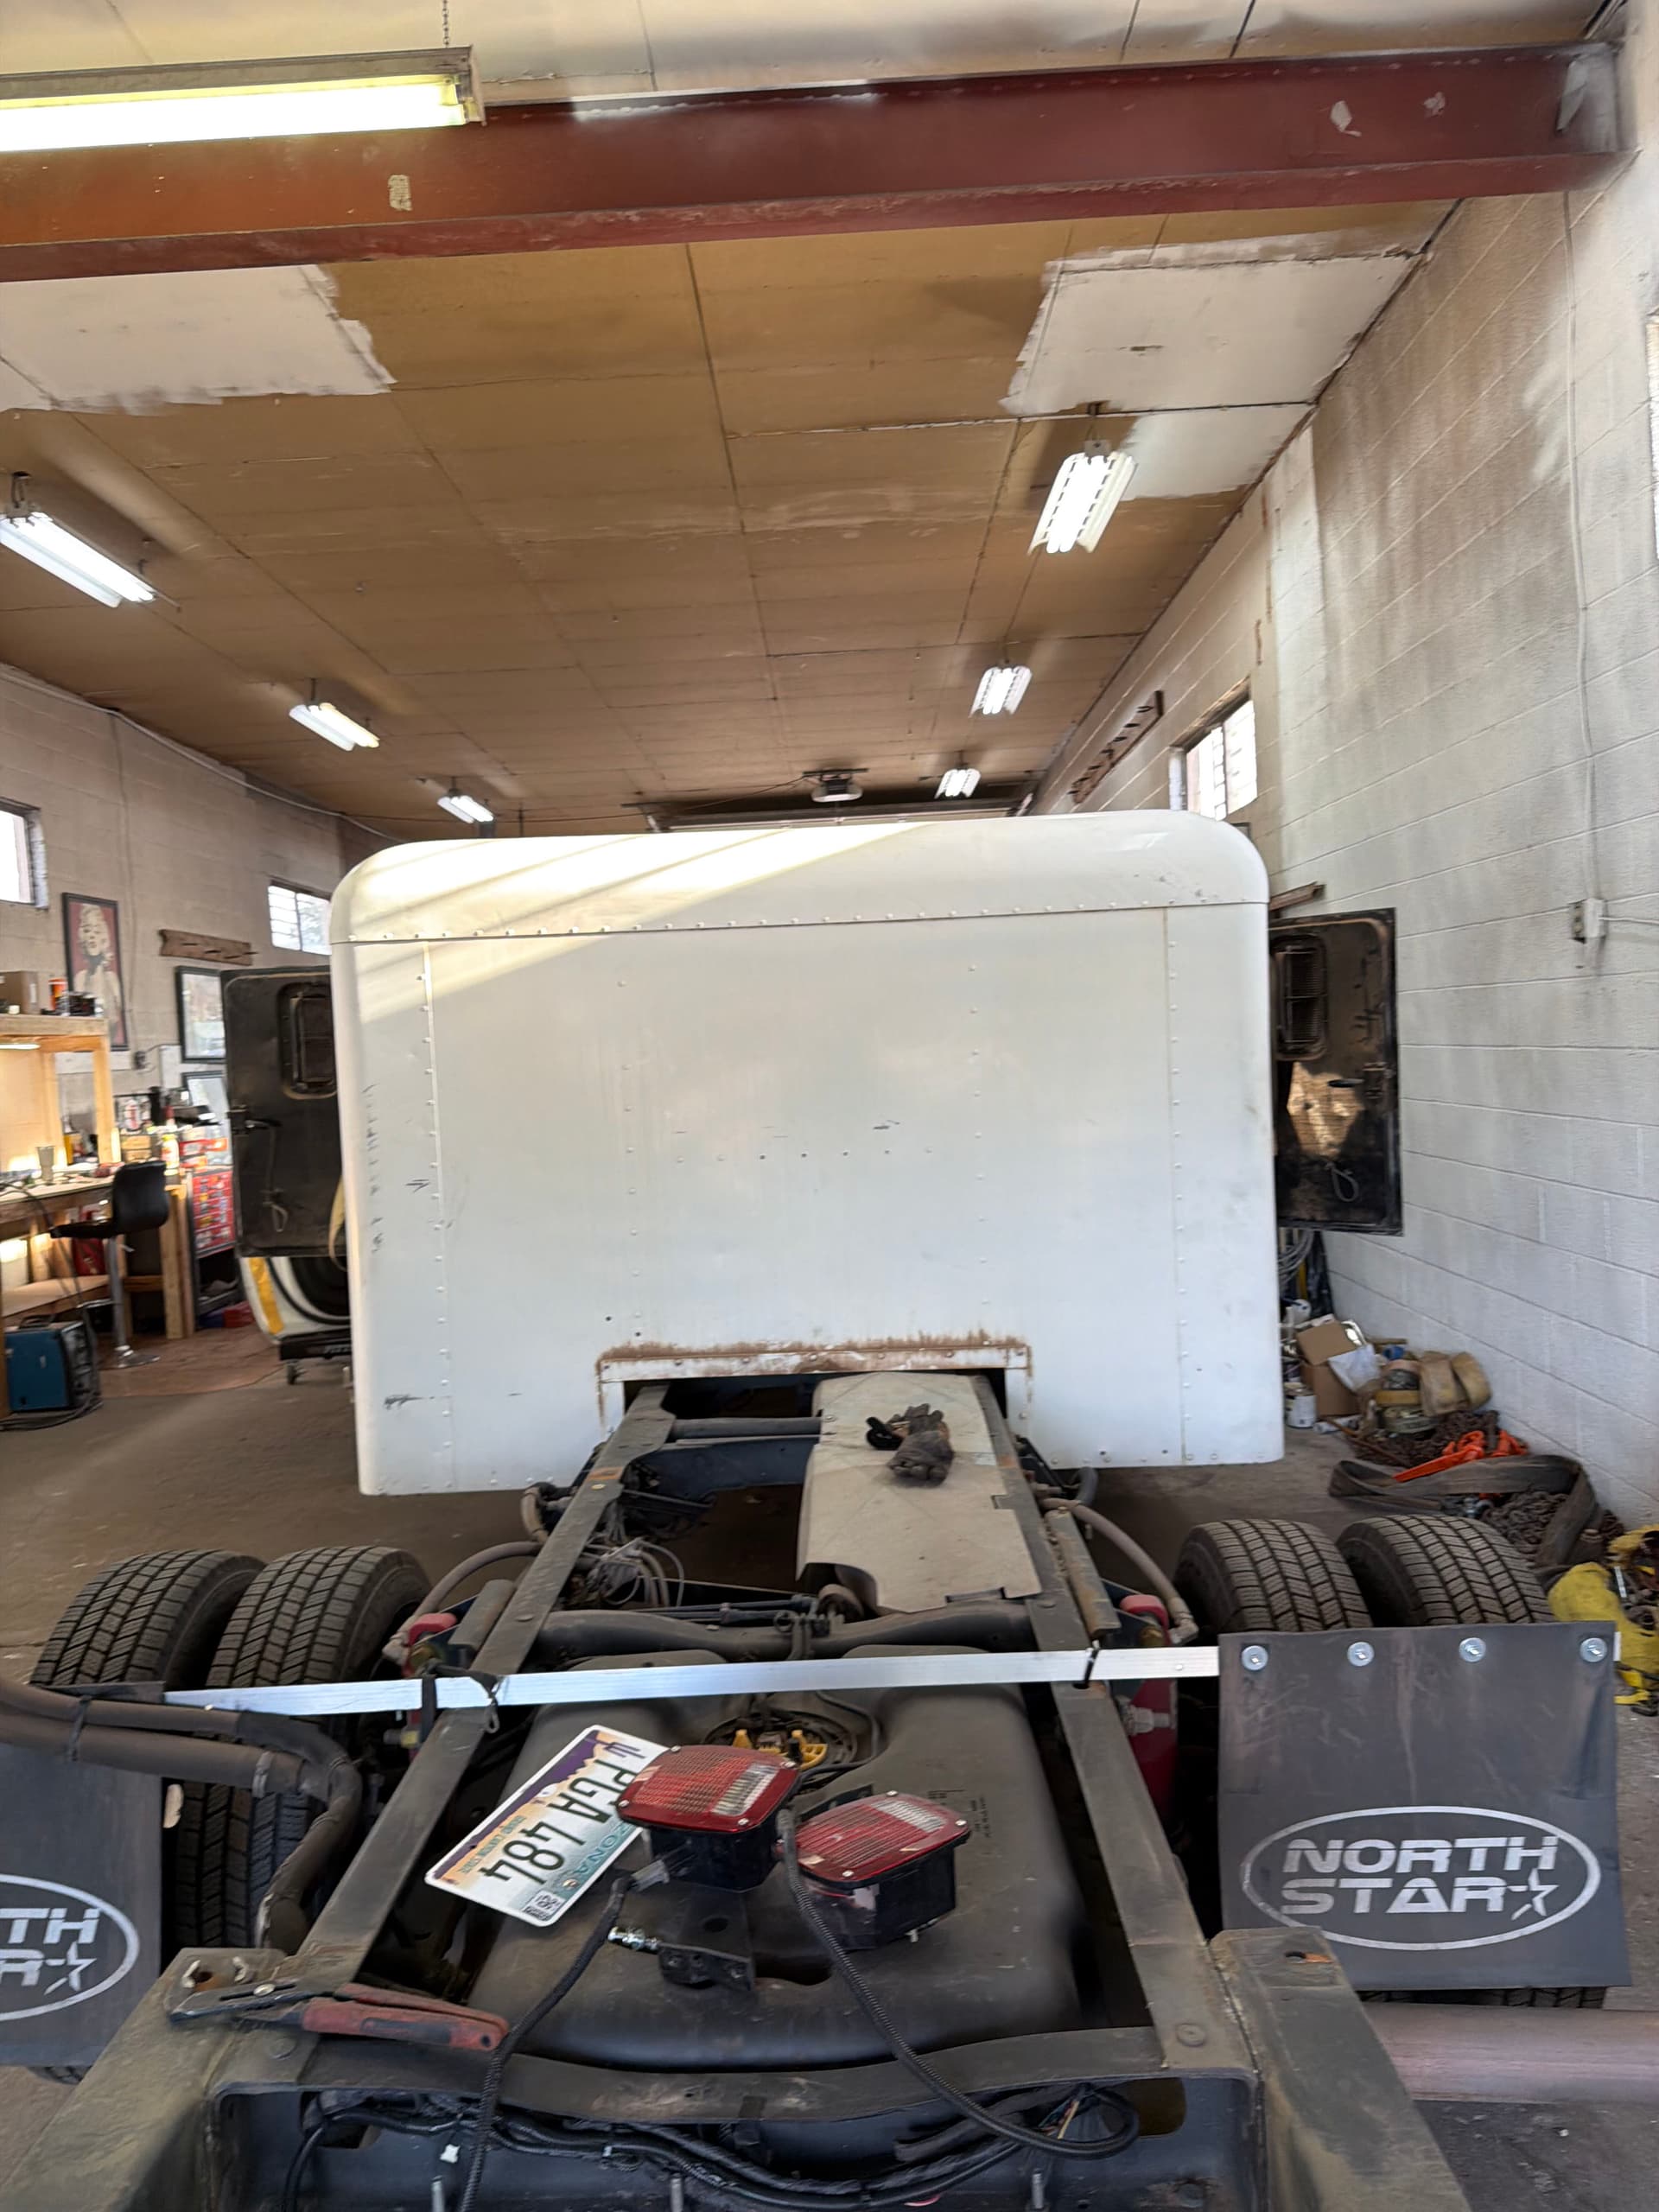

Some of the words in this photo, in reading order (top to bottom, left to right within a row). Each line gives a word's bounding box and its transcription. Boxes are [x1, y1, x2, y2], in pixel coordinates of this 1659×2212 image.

[478, 1821, 587, 1885] 484
[574, 1821, 632, 1874] ZONA
[1282, 1836, 1558, 1873] NORTH
[1281, 1876, 1507, 1915] STAR
